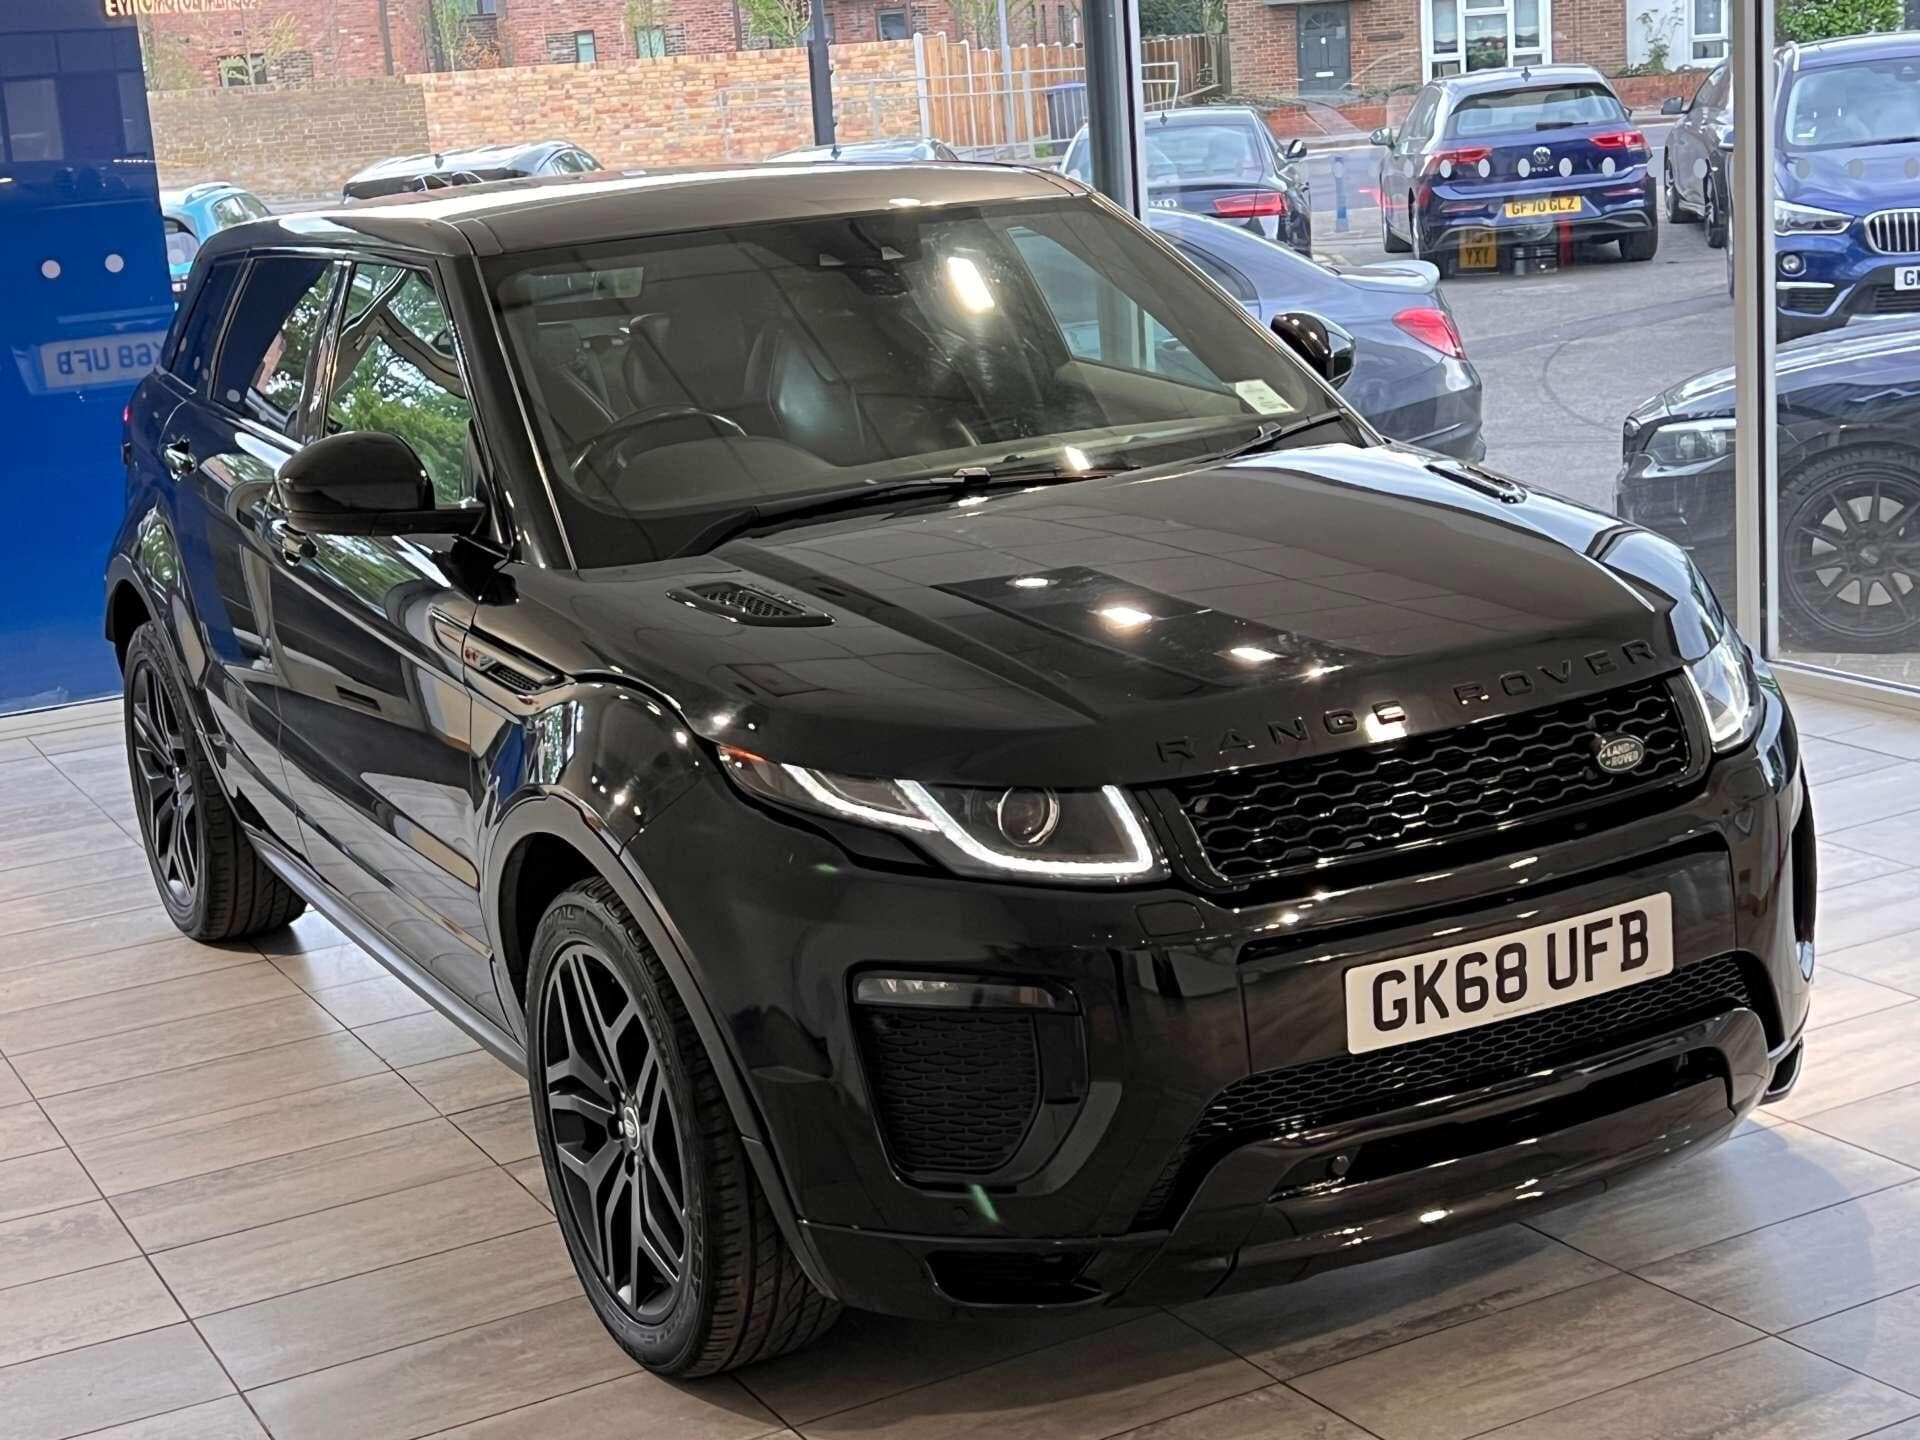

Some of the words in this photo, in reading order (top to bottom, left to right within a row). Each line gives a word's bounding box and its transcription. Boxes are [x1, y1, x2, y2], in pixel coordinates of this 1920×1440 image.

[1156, 700, 1406, 764] RANGE
[1454, 639, 1656, 706] ROVER
[1372, 942, 1528, 1032] GK68
[1547, 909, 1649, 990] UFB
